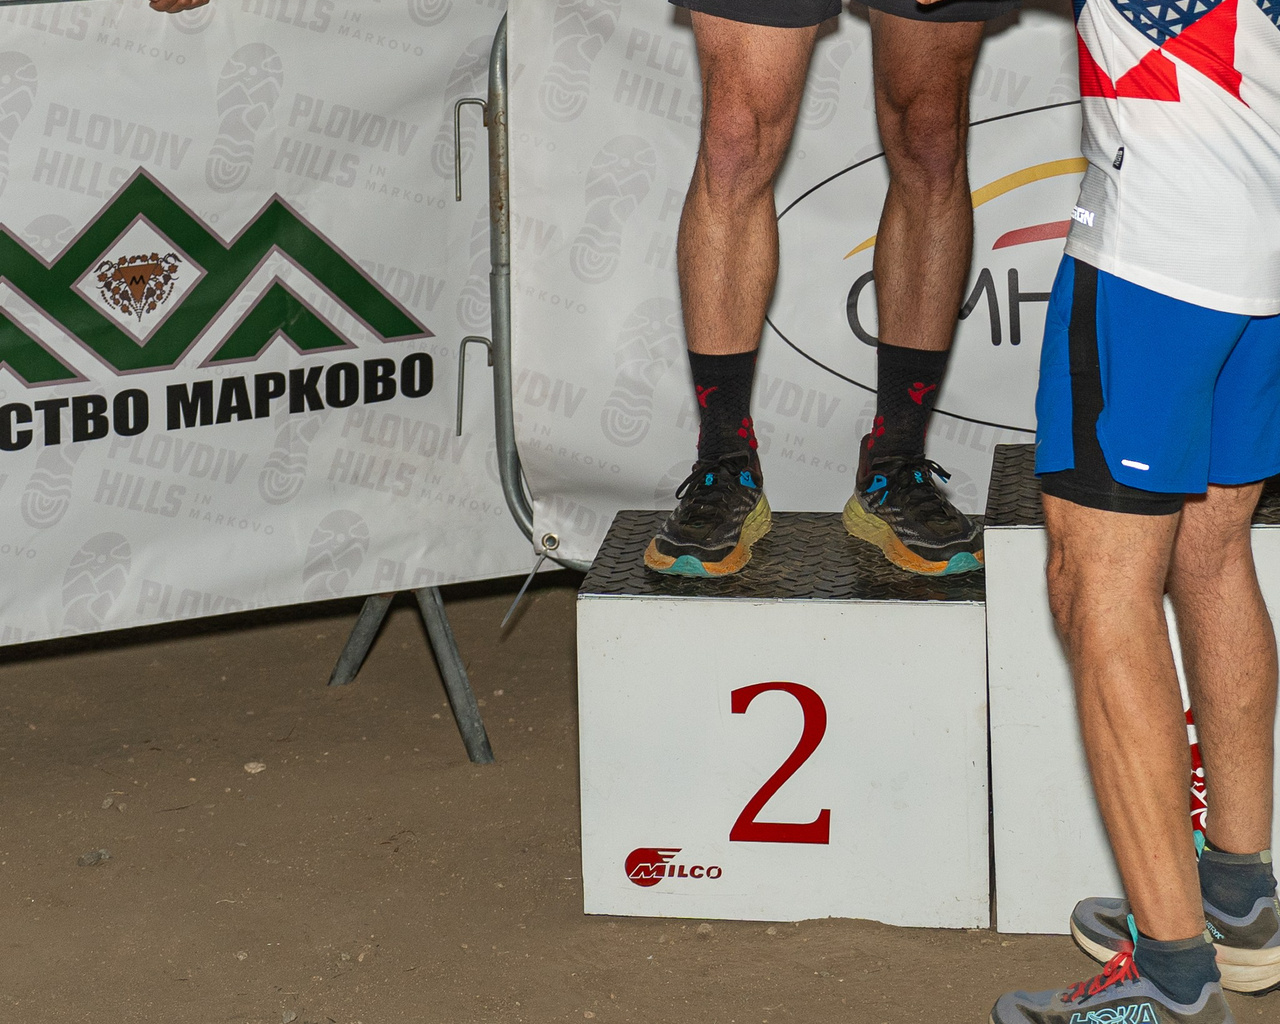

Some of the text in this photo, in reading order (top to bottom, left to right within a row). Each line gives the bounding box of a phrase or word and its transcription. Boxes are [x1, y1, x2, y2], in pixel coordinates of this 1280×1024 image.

[96, 32, 187, 66] MARKOVO
[337, 25, 425, 58] MARKOVO
[43, 101, 193, 171] PLOVDIV
[288, 92, 419, 157] PLOVDIV
[273, 136, 361, 189] HILLS
[363, 179, 447, 210] MARKOVO
[166, 352, 434, 431] МАРКОВО
[106, 433, 249, 486] PLOVDIV
[341, 405, 472, 465] PLOVDIV
[94, 469, 187, 518] HILLS
[327, 447, 417, 498] HILLS
[188, 508, 275, 536] MARKOVO
[729, 681, 831, 845] 2
[630, 862, 723, 881] MILCO
